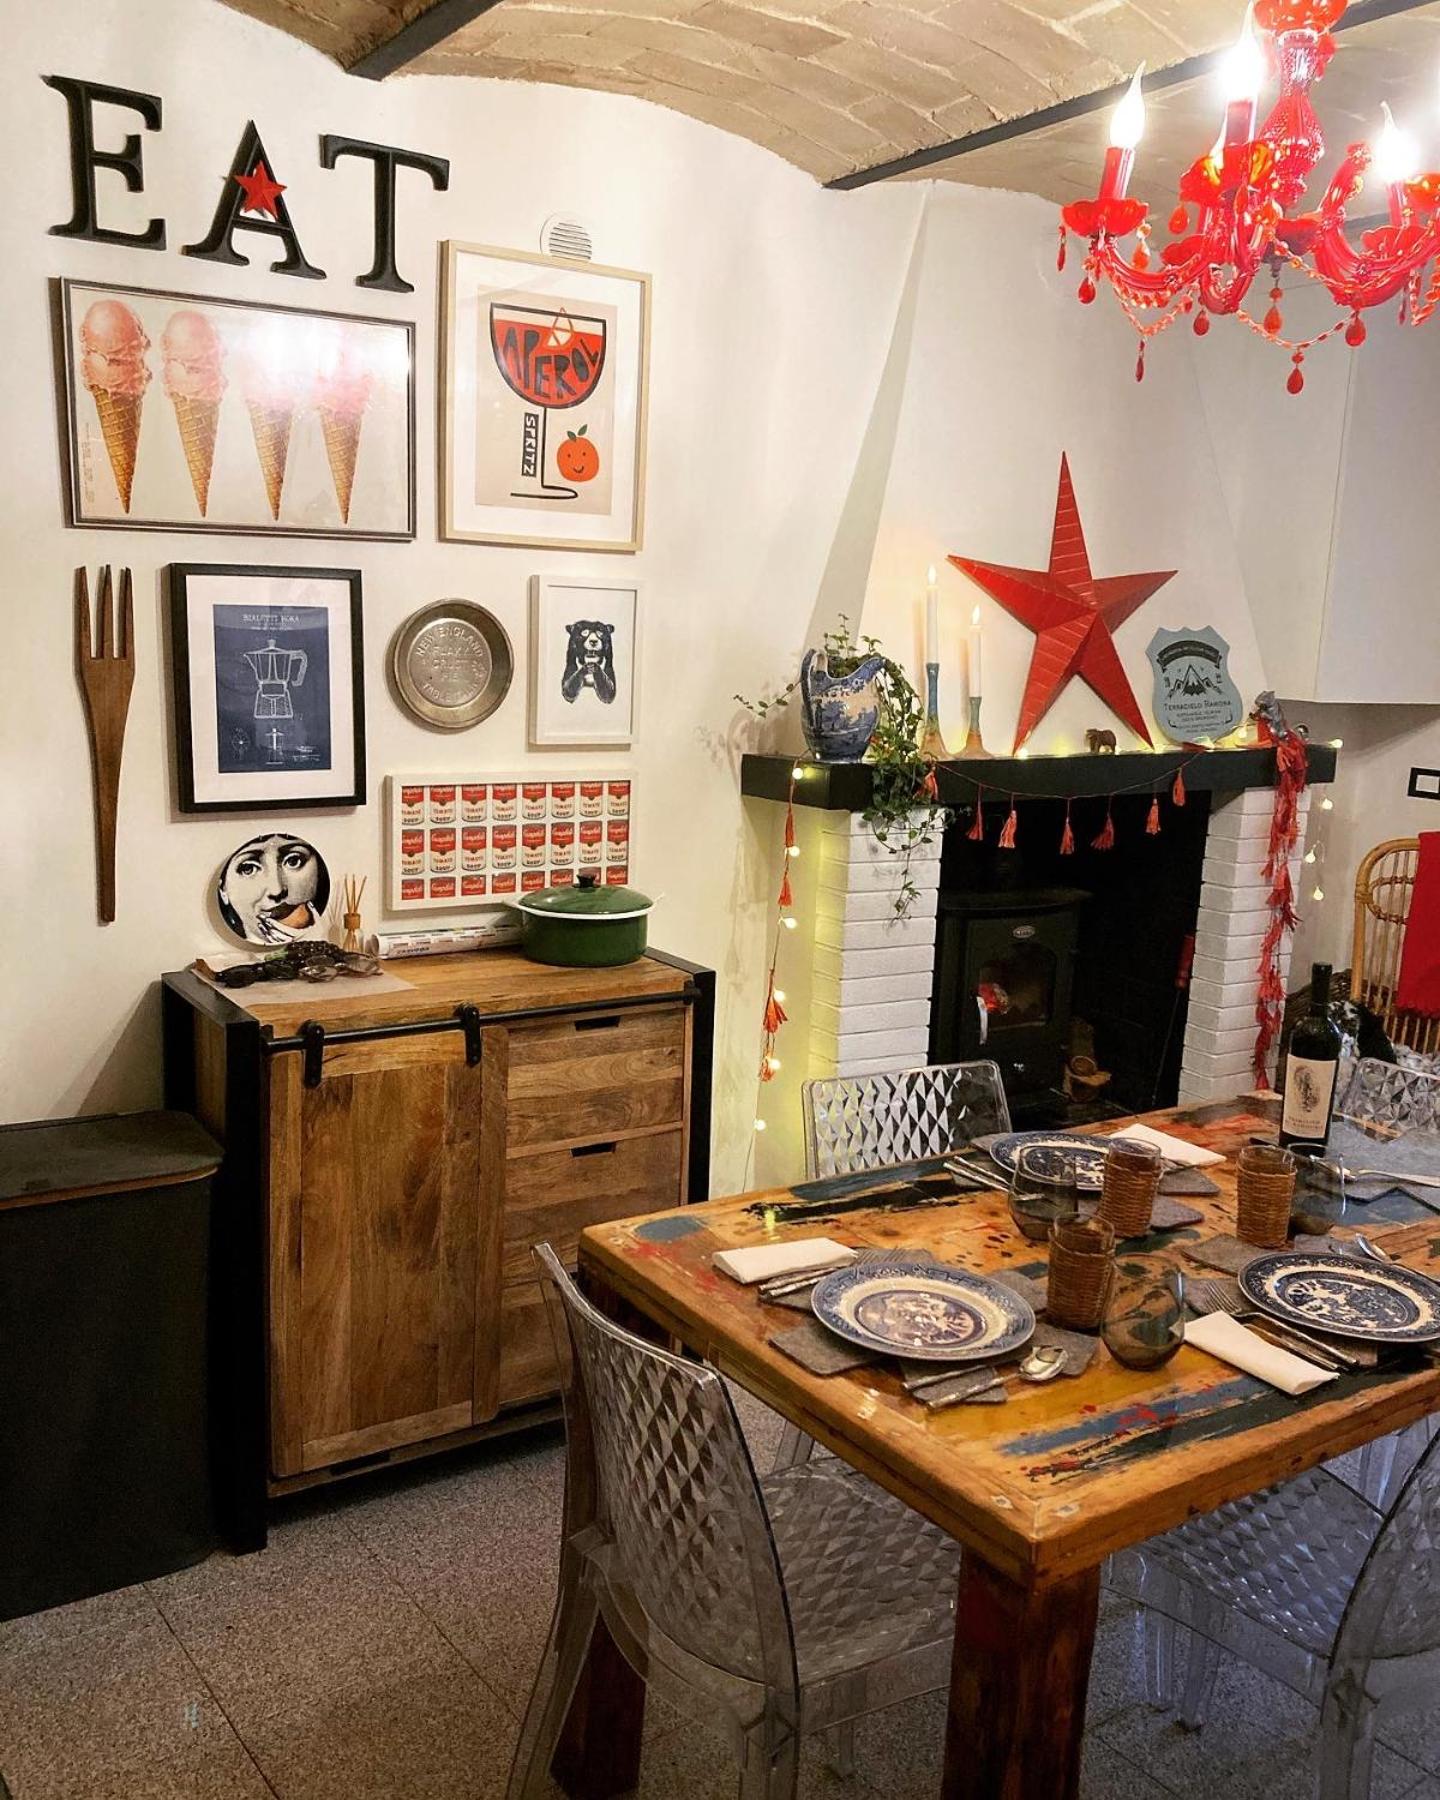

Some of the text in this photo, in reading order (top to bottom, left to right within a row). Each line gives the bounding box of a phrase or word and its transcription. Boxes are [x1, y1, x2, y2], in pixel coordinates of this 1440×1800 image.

[41, 75, 450, 293] EAT
[503, 326, 599, 399] APEROL
[523, 414, 537, 476] SPRITZ
[416, 626, 484, 657] NEW ENGLAND
